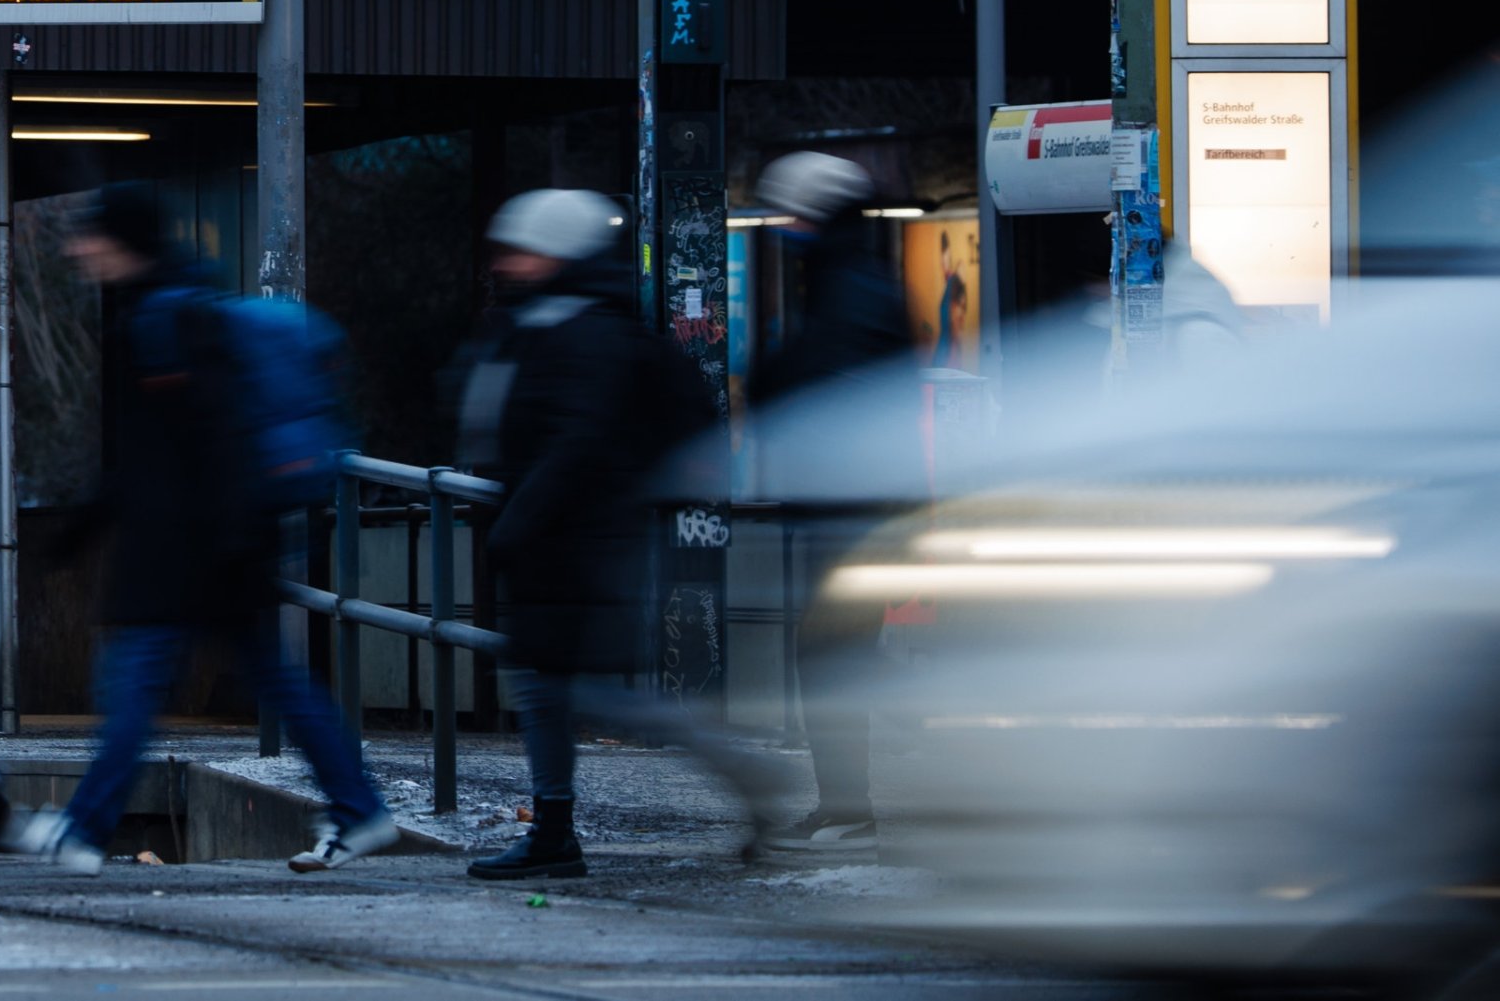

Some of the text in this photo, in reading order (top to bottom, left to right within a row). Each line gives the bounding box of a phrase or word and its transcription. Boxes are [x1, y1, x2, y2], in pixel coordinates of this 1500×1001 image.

[1203, 102, 1254, 112] S-Bahnhof
[1203, 113, 1304, 125] Greifswalder Straße
[1044, 134, 1110, 159] S-Bahnhof Greifswalde
[1205, 148, 1266, 160] Tarifbereich
